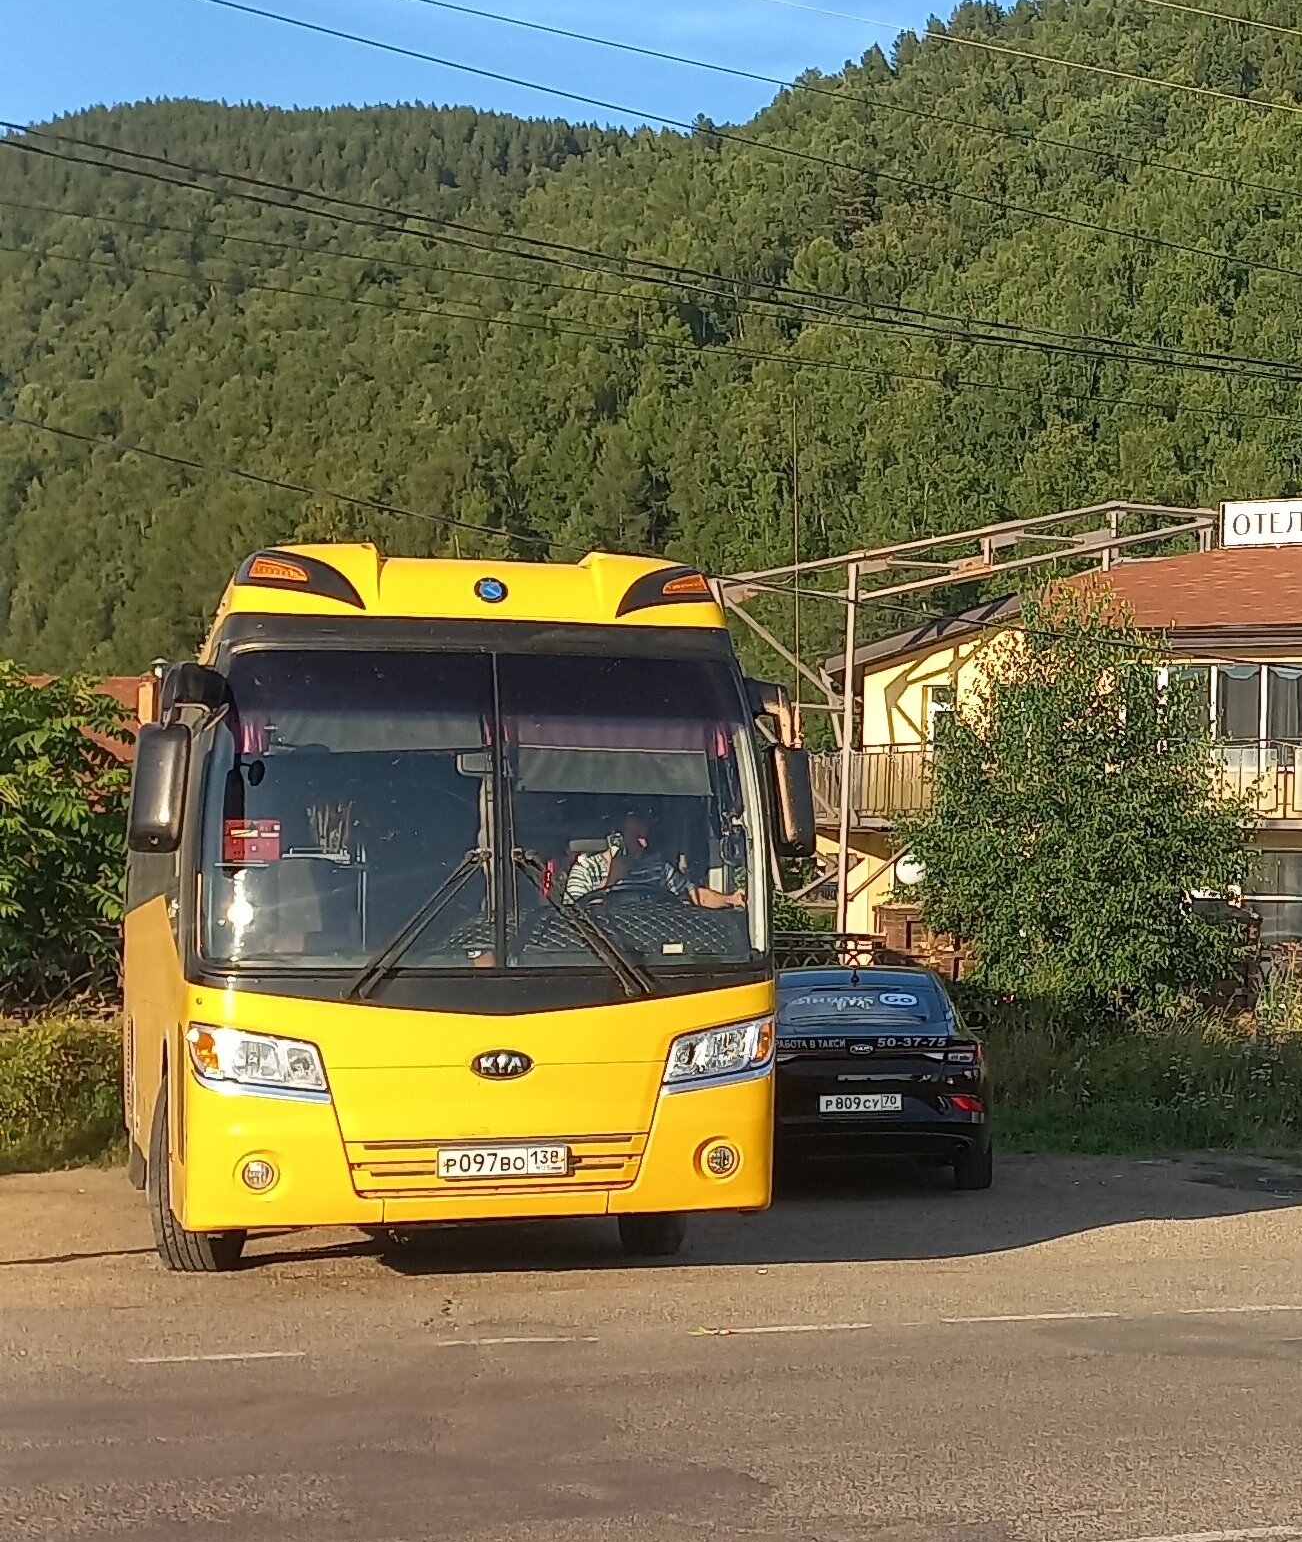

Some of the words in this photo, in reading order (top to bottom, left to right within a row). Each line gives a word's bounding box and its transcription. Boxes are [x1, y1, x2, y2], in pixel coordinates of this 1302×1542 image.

[809, 1039, 817, 1049] В
[818, 1038, 846, 1048] ТАКСИ
[876, 1037, 947, 1048] 50-37-75
[479, 1053, 523, 1074] KIA
[825, 1096, 880, 1110] Р809СУ
[882, 1095, 898, 1105] 70
[444, 1152, 526, 1173] Р097ВО
[530, 1149, 560, 1165] 138
